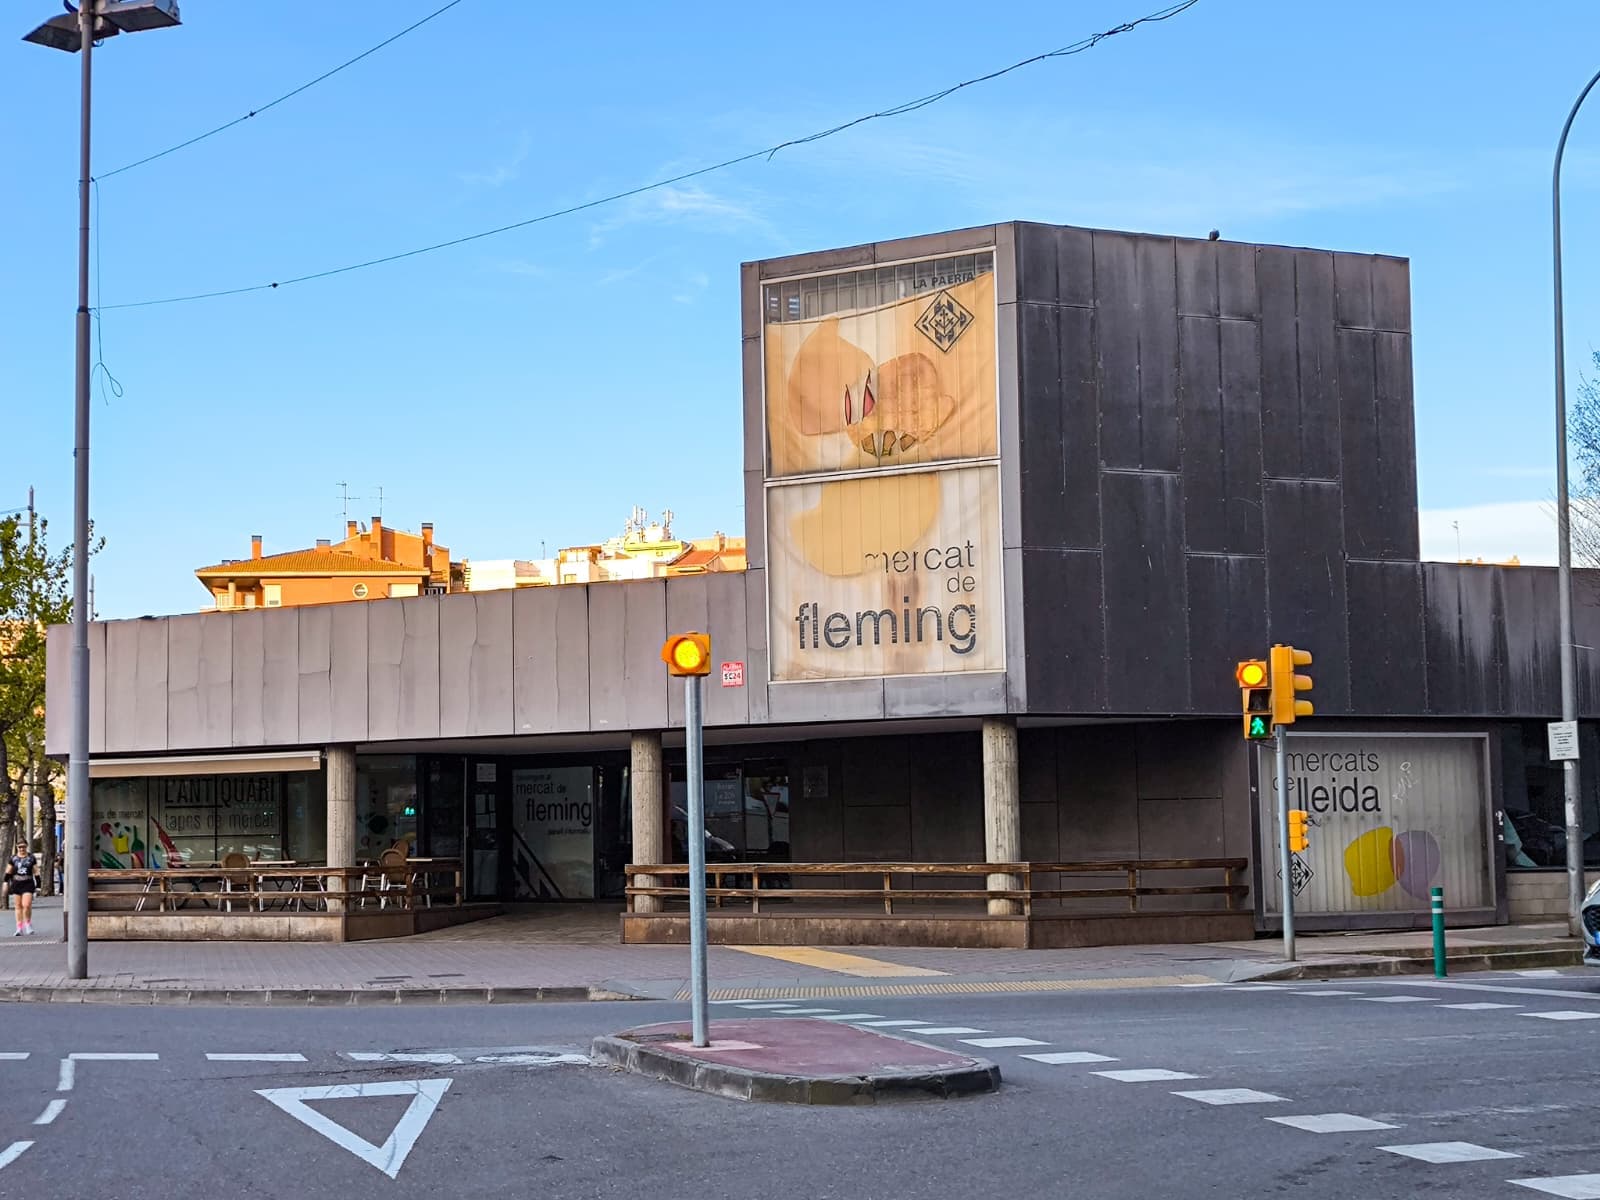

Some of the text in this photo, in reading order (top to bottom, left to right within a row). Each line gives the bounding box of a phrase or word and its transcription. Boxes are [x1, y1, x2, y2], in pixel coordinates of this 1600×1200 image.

[913, 271, 975, 289] LA PAERIA
[947, 571, 976, 593] de
[795, 596, 976, 655] fleming
[164, 777, 274, 806] L'ANTQUARI
[516, 782, 554, 795] mercat
[1298, 777, 1381, 813] lleida
[527, 797, 592, 827] fleming
